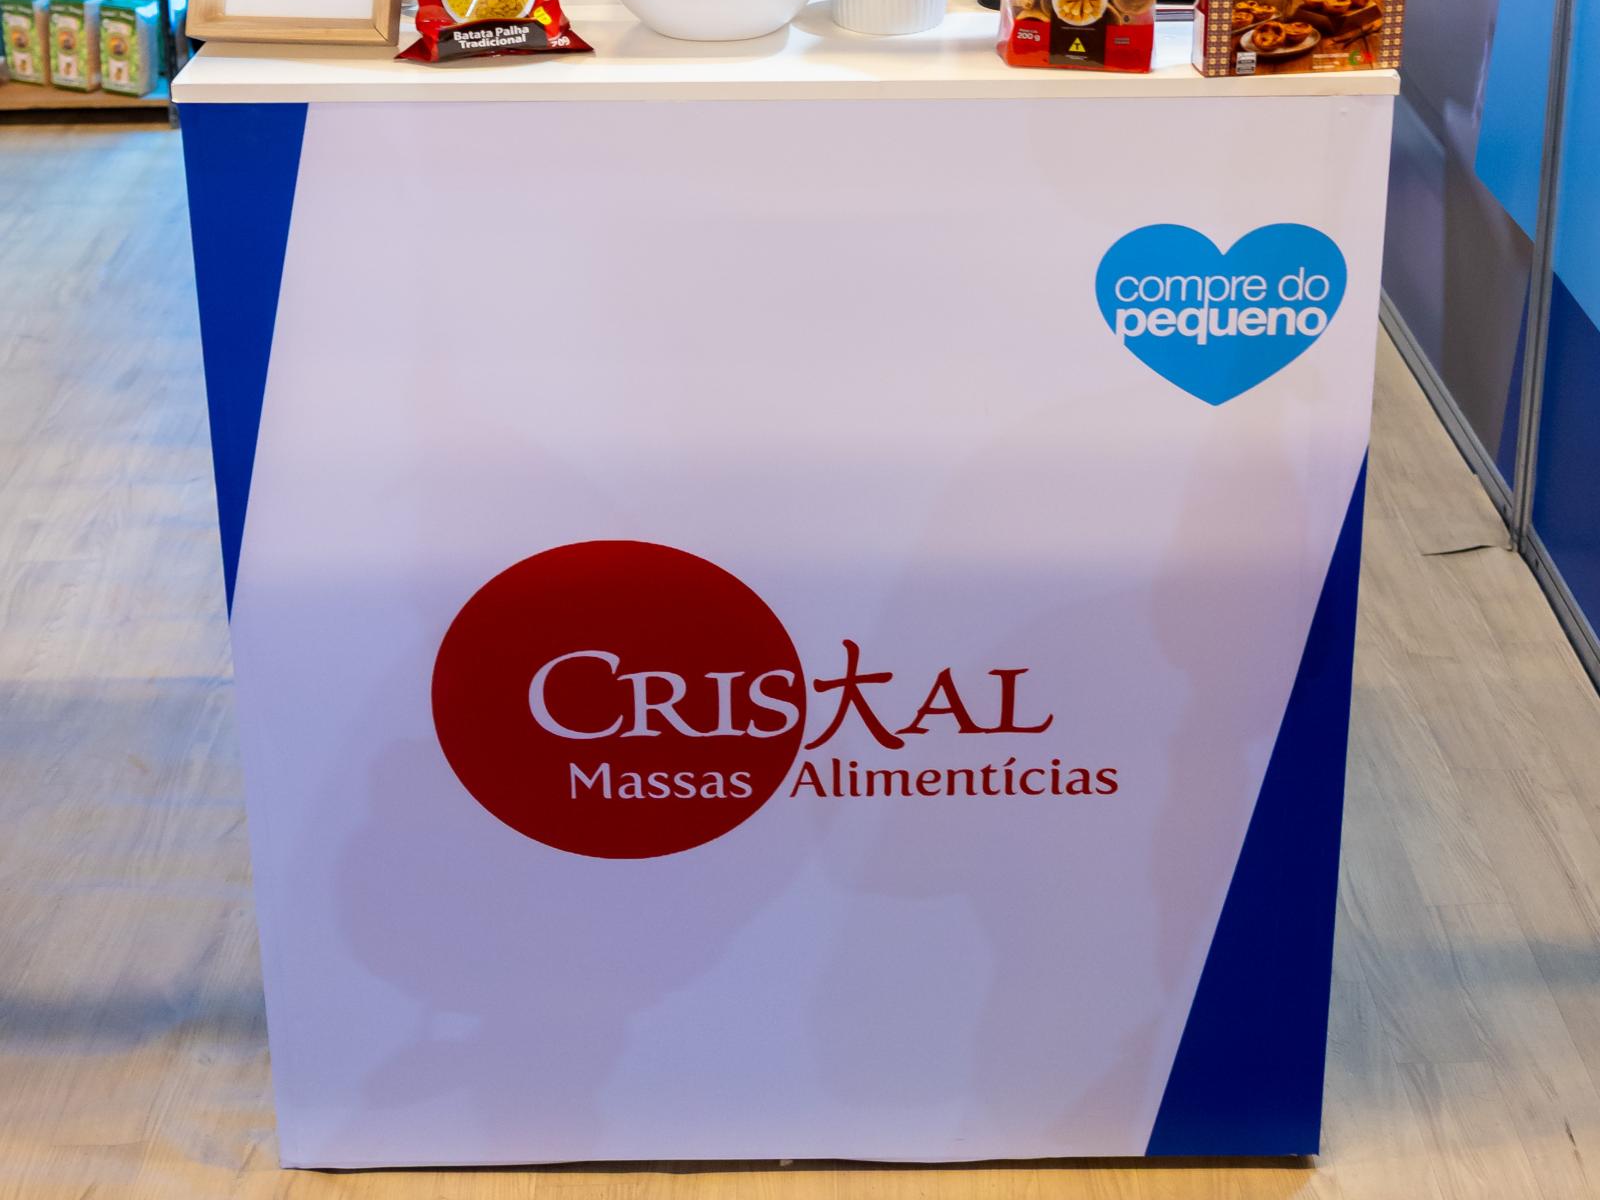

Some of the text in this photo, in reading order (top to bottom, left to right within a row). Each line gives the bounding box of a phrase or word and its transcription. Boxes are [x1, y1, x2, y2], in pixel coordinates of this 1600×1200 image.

[453, 25, 530, 41] Batata Palha
[458, 34, 527, 49] Tradicional
[1115, 266, 1330, 309] compre do
[1115, 306, 1328, 346] pequeno
[528, 638, 1054, 751] CRISTAL
[569, 757, 1119, 800] Massas Alimentícias
